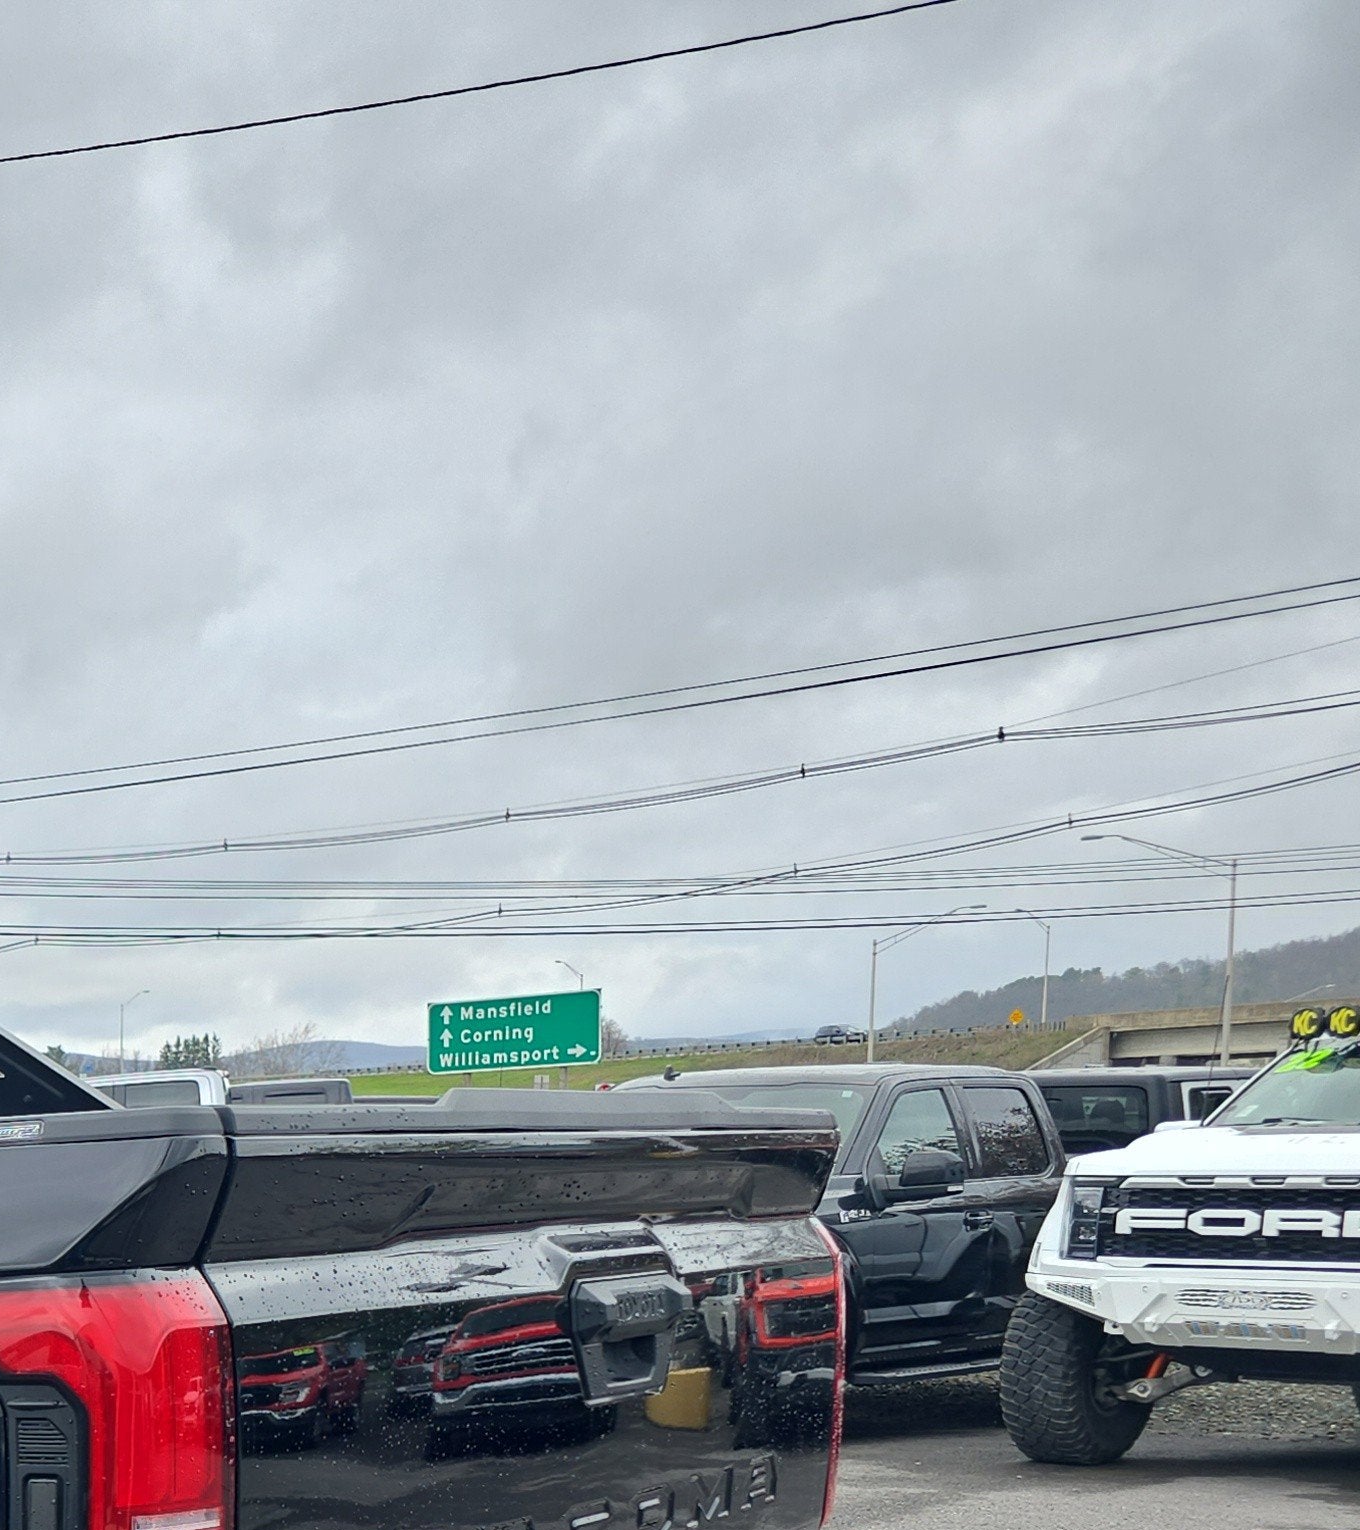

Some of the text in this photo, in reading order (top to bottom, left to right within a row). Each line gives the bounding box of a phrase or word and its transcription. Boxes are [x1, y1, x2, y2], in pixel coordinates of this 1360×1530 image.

[460, 999, 552, 1021] Mansfield
[1330, 1008, 1356, 1034] KC
[460, 1026, 534, 1044] Corning
[1293, 1010, 1318, 1036] KC
[439, 1045, 560, 1068] Williamsport
[1115, 1208, 1360, 1238] FOR
